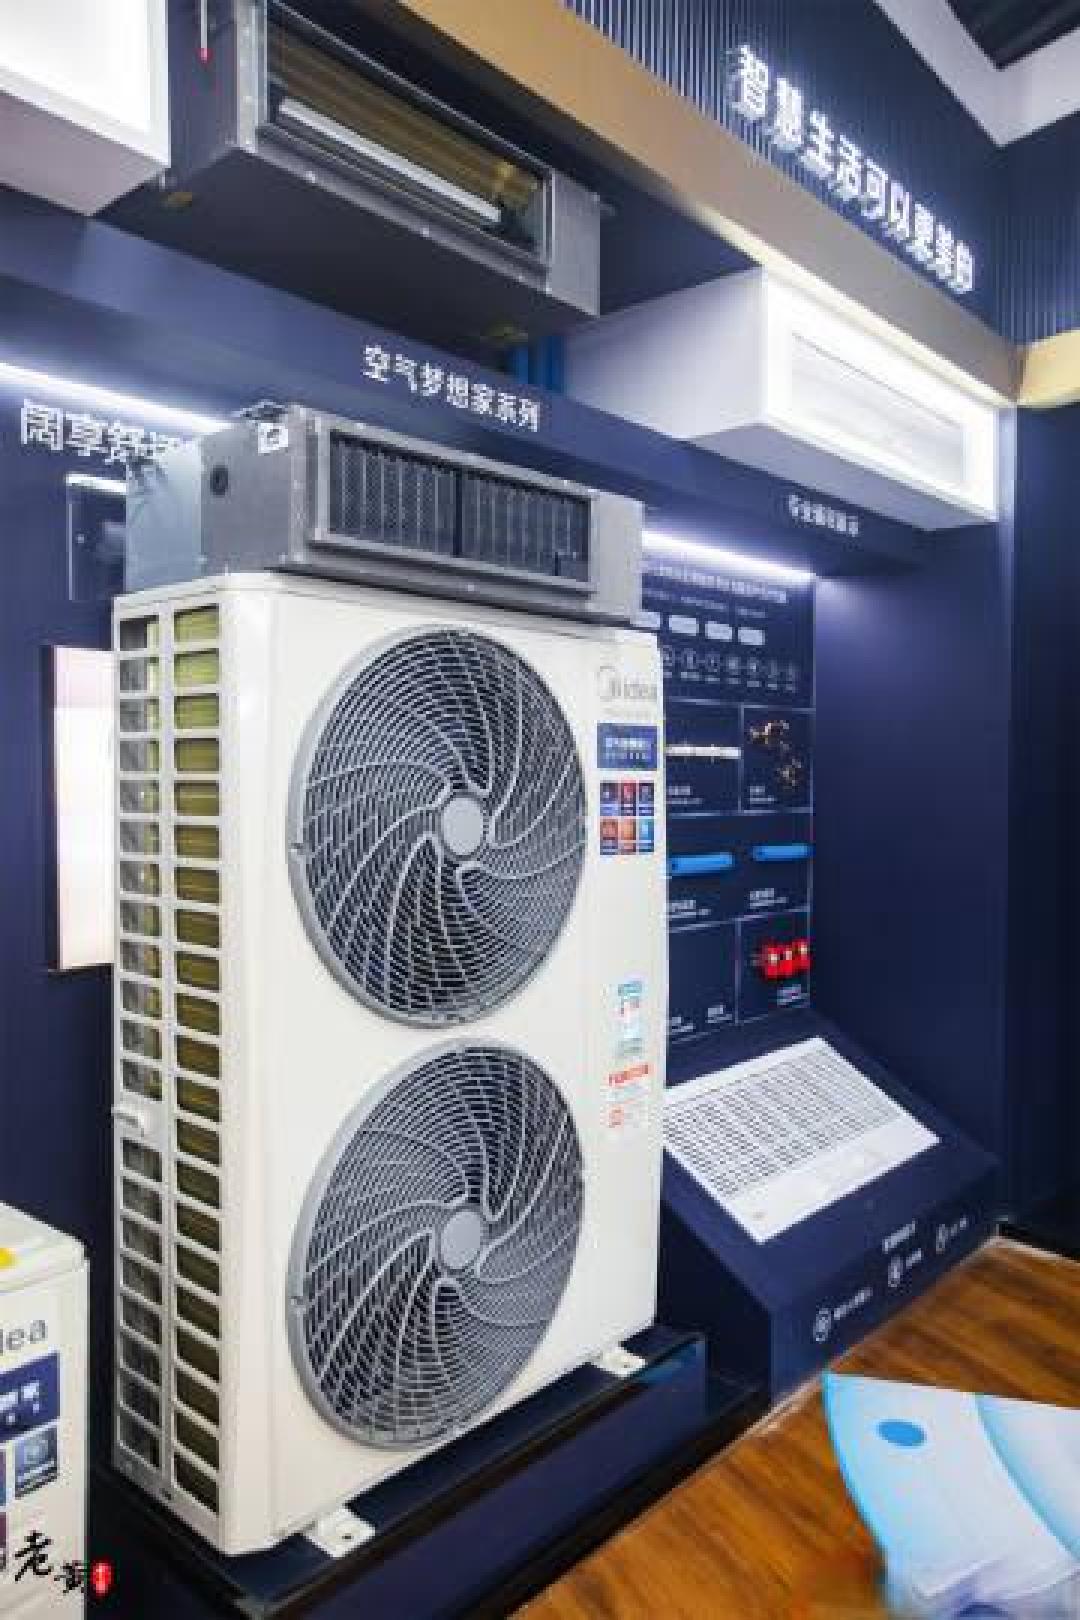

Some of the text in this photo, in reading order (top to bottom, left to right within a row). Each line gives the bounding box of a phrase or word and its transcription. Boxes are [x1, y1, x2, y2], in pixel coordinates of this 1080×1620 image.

[730, 44, 975, 293] 智慧生活可以更美的
[362, 344, 541, 433] 空气梦想家系列
[0, 1319, 48, 1356] ea
